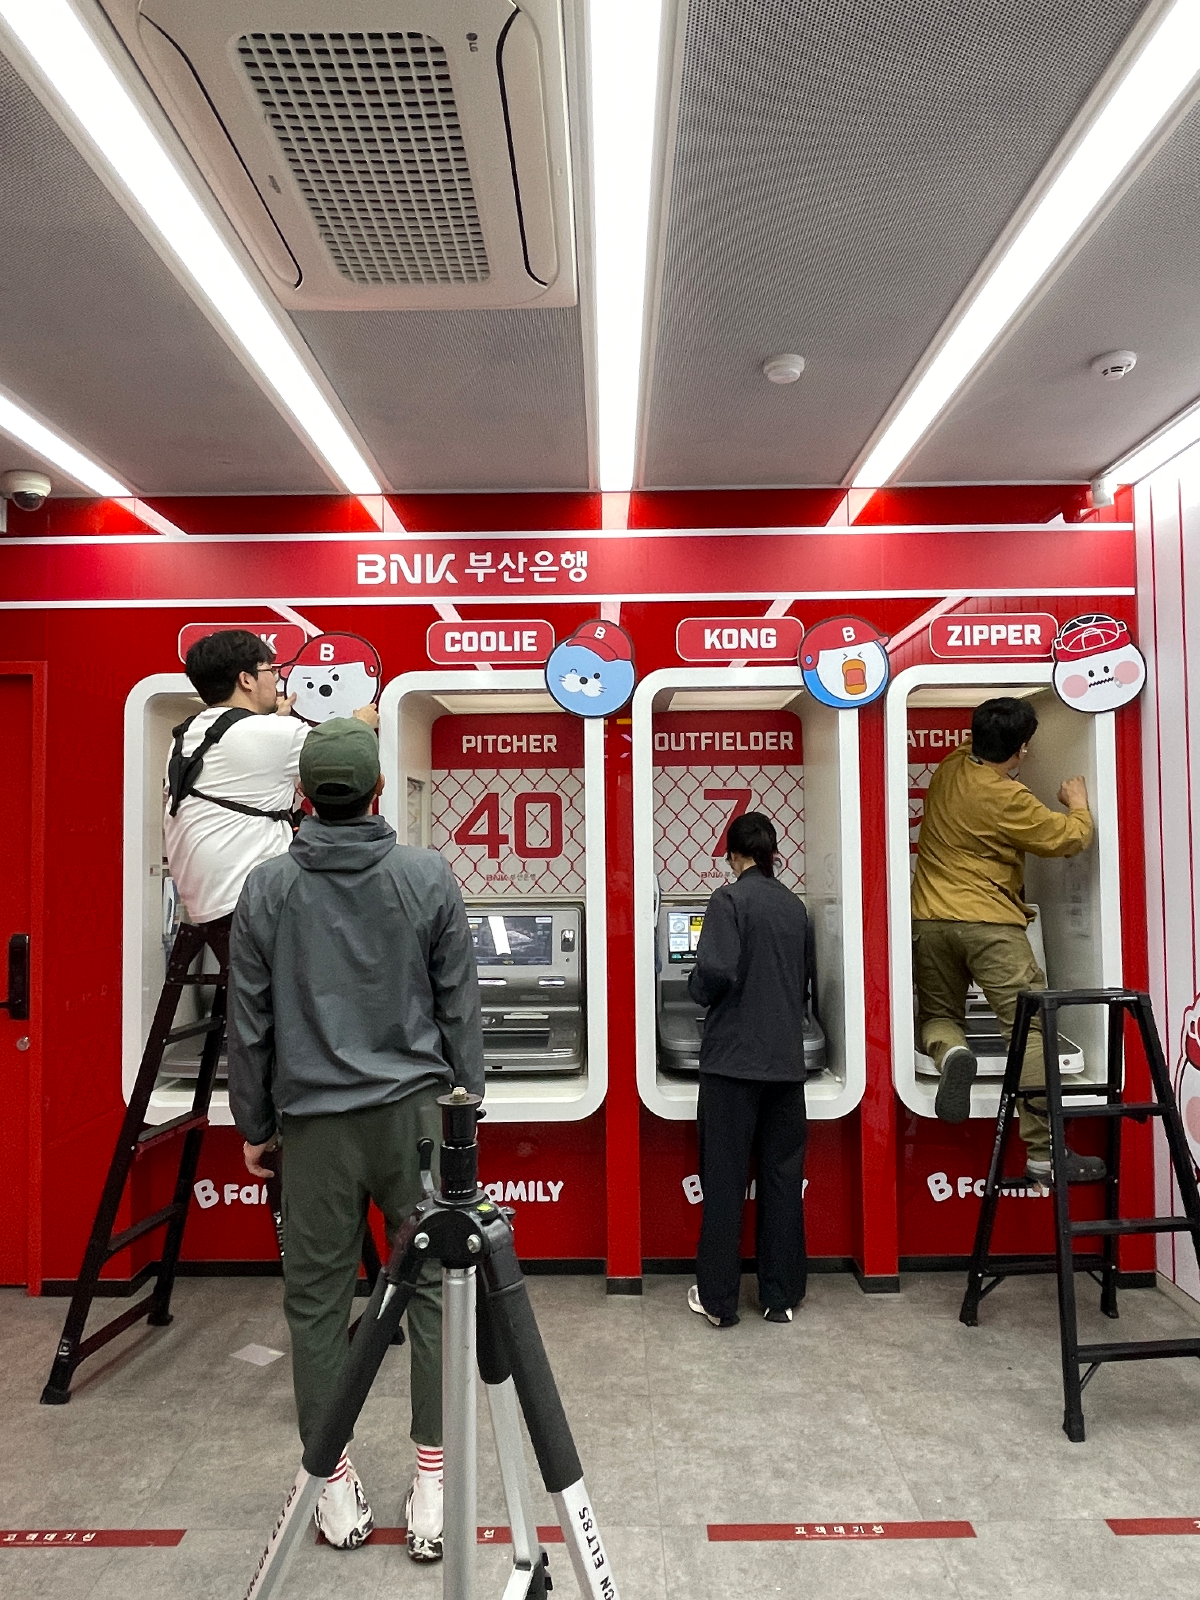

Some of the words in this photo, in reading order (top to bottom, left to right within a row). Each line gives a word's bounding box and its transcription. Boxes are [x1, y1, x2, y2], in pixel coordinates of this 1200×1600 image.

[469, 42, 479, 52] LG
[357, 553, 458, 585] BNK
[464, 550, 588, 583] 부산은행
[444, 630, 538, 653] COOLIE
[704, 627, 777, 650] KONG
[842, 626, 856, 642] B
[946, 624, 1042, 646] ZIPPER
[319, 643, 335, 662] B
[461, 734, 558, 753] PITCHER
[654, 731, 794, 751] OUTFIELDER
[453, 792, 564, 859] 40
[703, 788, 752, 857] 7
[193, 1178, 220, 1209] B
[682, 1174, 704, 1205] B
[927, 1172, 953, 1202] B
